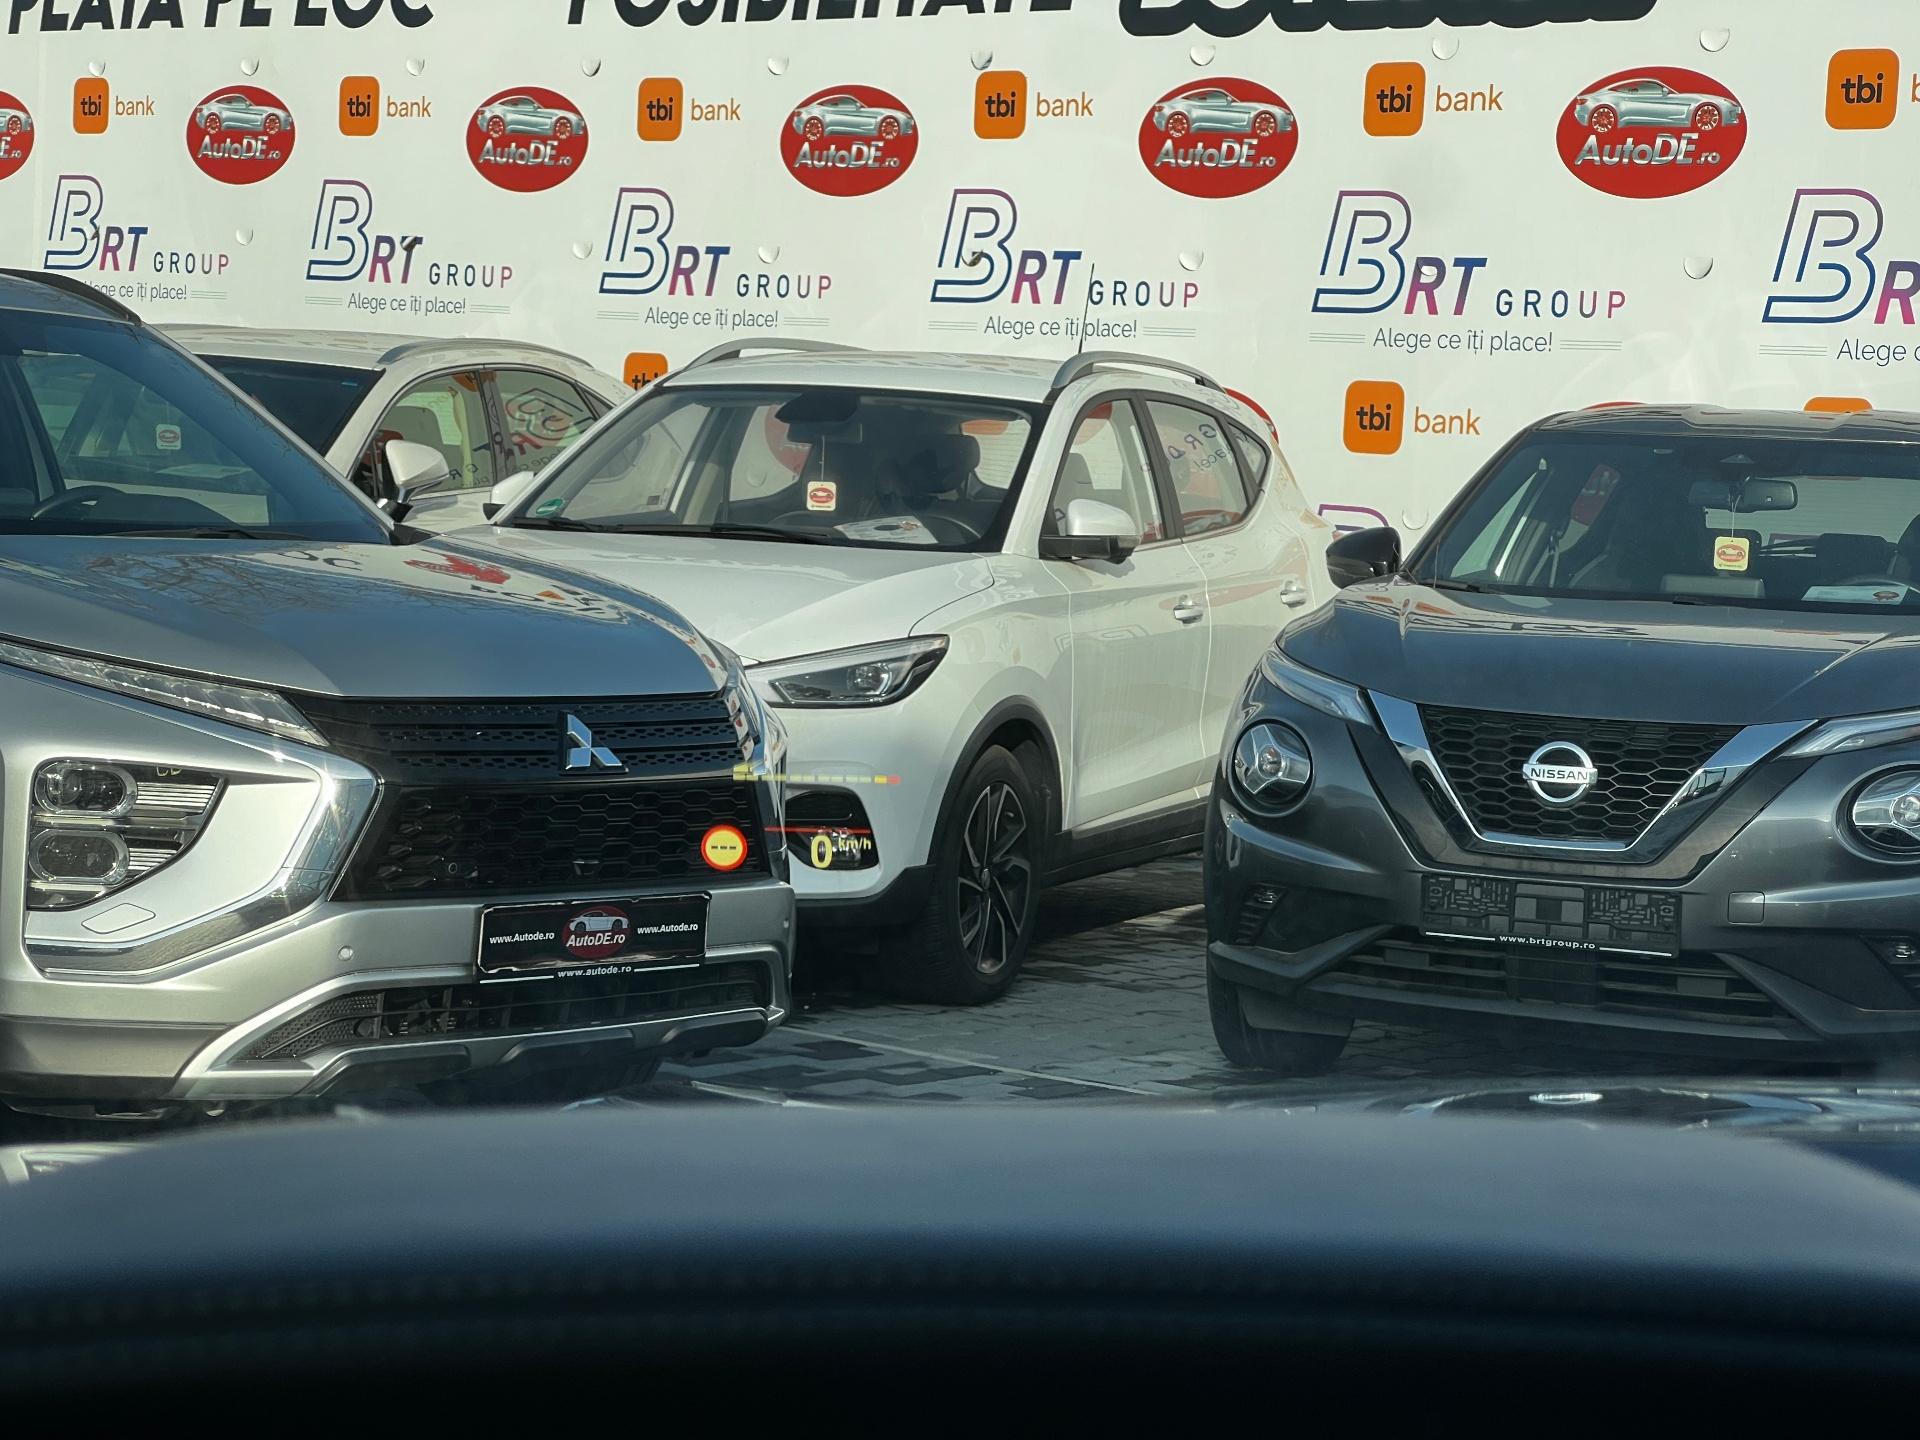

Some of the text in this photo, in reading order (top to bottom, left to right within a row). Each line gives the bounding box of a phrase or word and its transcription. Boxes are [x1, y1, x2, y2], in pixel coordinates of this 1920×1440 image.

[1376, 84, 1504, 114] tbi bank
[1841, 73, 1884, 104] tbi
[81, 94, 155, 116] tbi bank
[347, 95, 432, 118] tbi bank
[647, 96, 741, 121] tbi bank
[985, 92, 1094, 118] tbi bank
[154, 251, 229, 275] GROUP
[429, 263, 513, 288] GROUP
[119, 286, 134, 297] ce
[150, 284, 187, 301] place!
[737, 274, 832, 299] GROUP
[1089, 280, 1199, 308] GROUP
[348, 293, 387, 313] Alege
[390, 299, 406, 311] ce
[425, 297, 466, 316] place!
[1496, 289, 1626, 319] GROUP
[644, 307, 689, 329] Alege
[693, 312, 711, 326] ce
[732, 311, 778, 331] place!
[984, 316, 1035, 340] Alege
[1039, 322, 1060, 336] ce
[1084, 320, 1137, 342] place!
[1373, 328, 1432, 353] Alege
[1437, 336, 1461, 350] ce
[1490, 331, 1552, 356] place!
[1836, 338, 1906, 366] Alege
[1356, 403, 1481, 435] tbi bank
[1530, 767, 1588, 780] NISSAN
[811, 835, 872, 869] 0 km/h
[489, 931, 555, 944] www.Autode.ro
[566, 932, 626, 948] AutoDE.ro
[637, 922, 699, 935] www.Autode.ro
[557, 964, 632, 978] www.autode.ro
